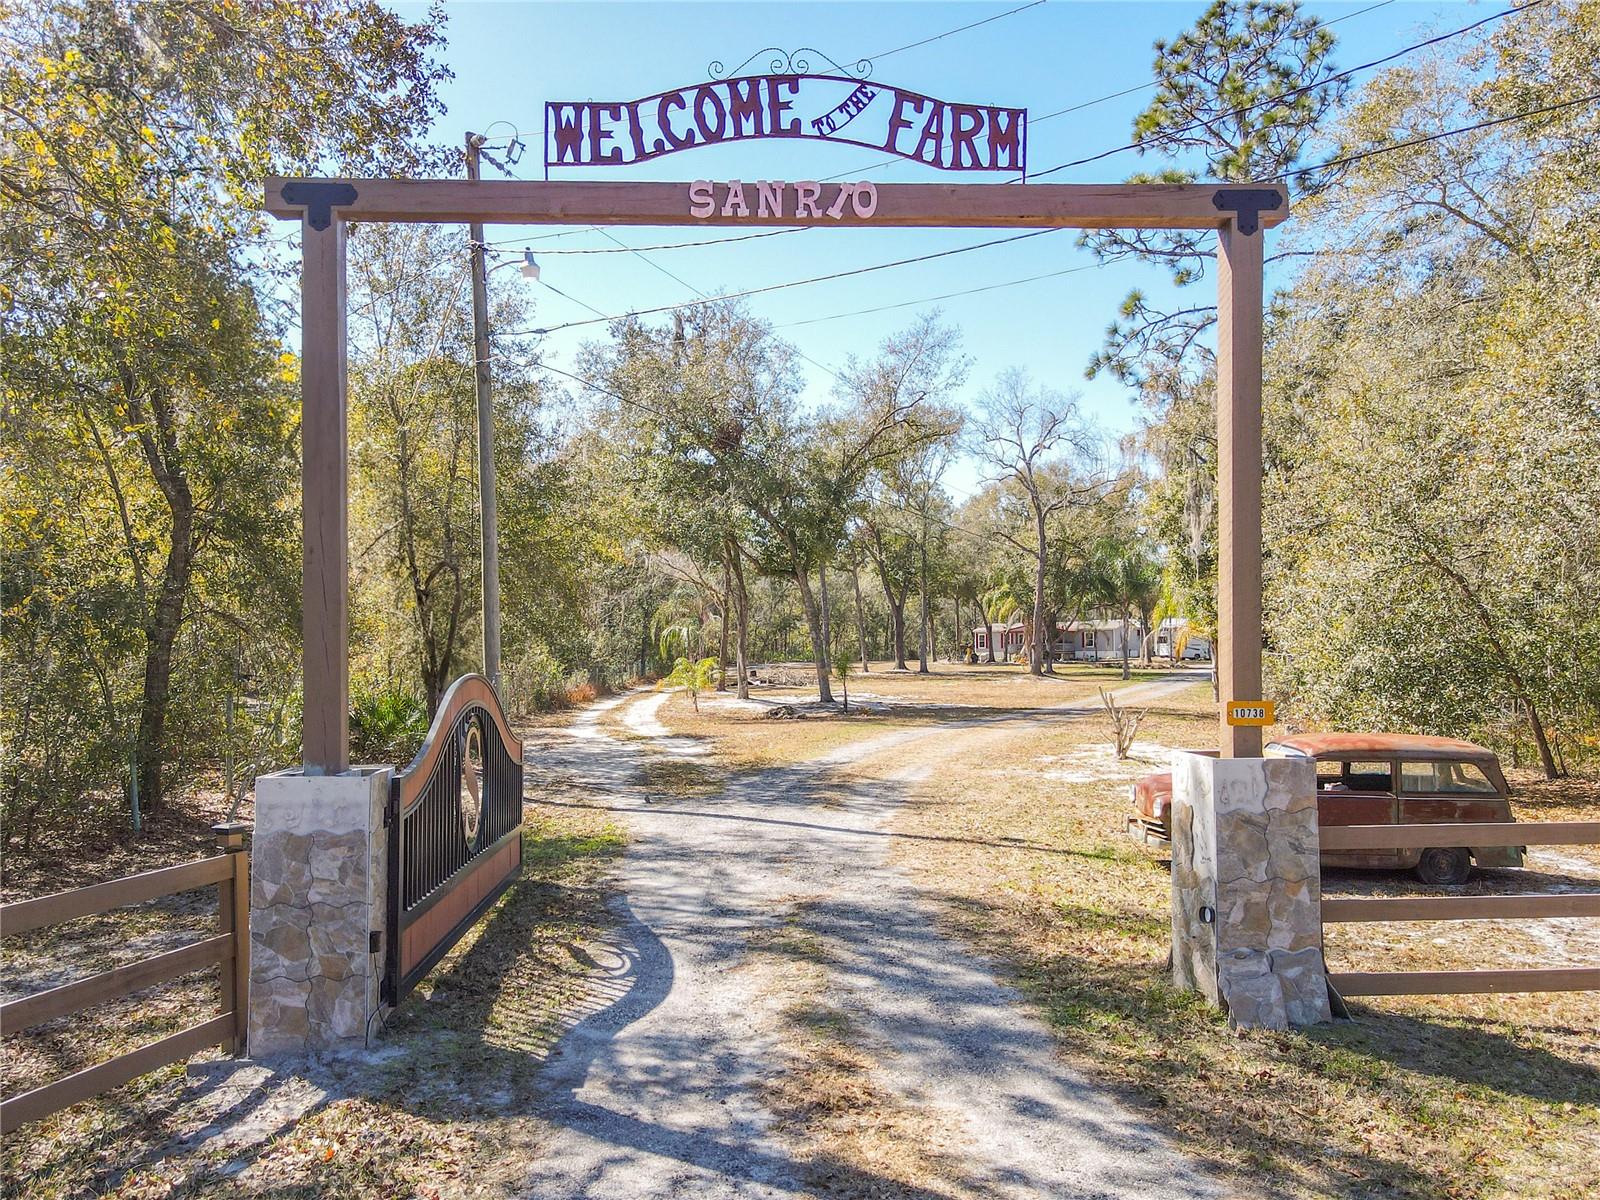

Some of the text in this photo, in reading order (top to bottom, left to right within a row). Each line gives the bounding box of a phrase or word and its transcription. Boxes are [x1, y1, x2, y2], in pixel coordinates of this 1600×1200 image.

[549, 75, 802, 164] WELCOME
[811, 84, 876, 137] TO THE
[885, 90, 1019, 170] FARM
[689, 179, 878, 220] SANRIO
[1234, 708, 1264, 718] 10738
